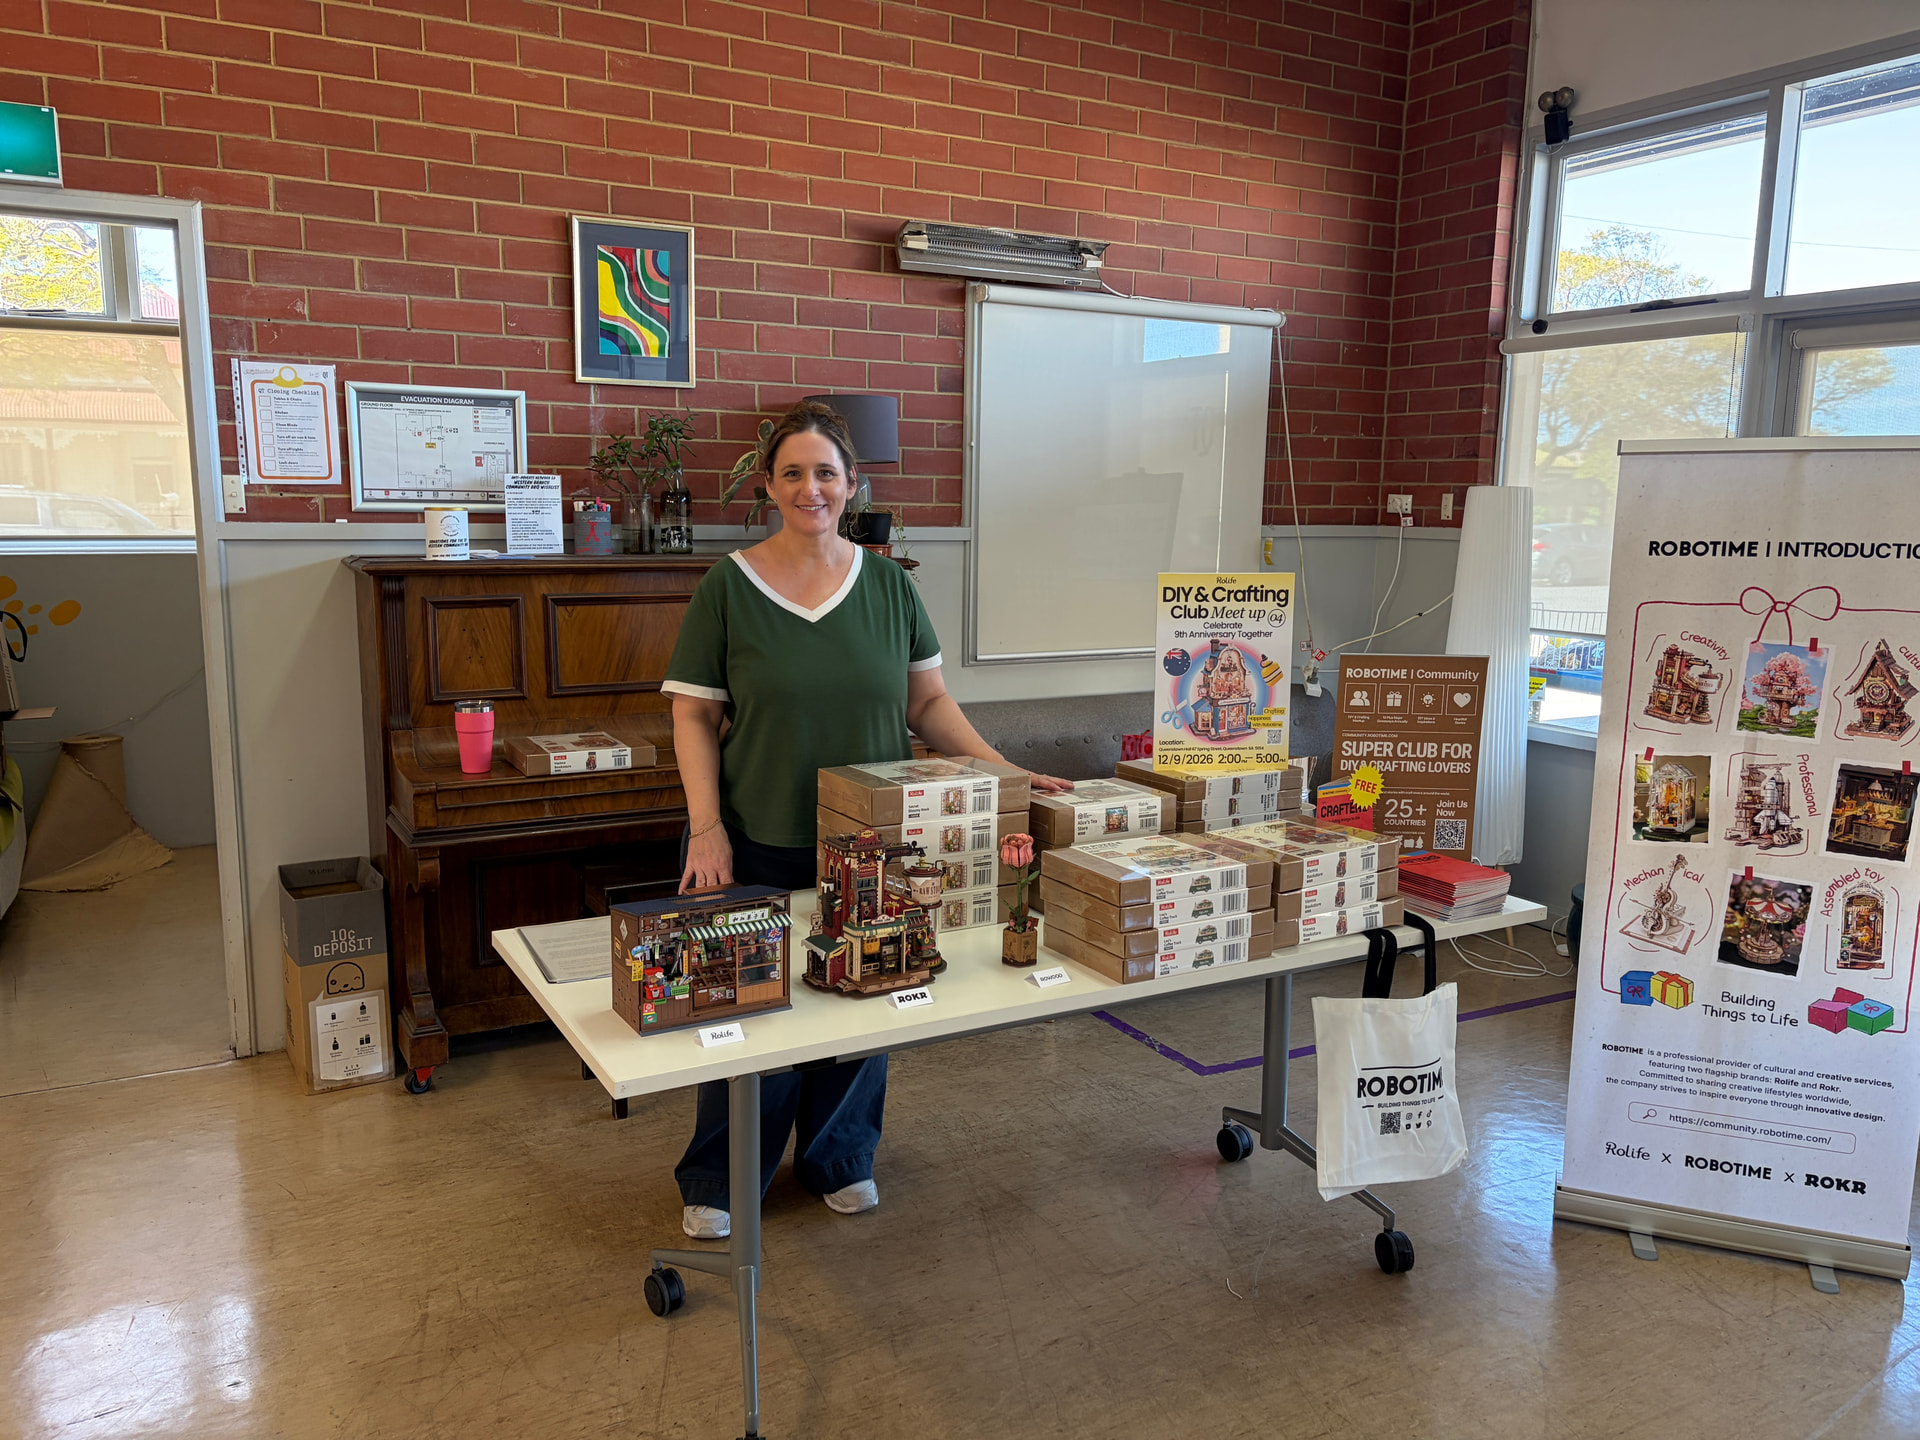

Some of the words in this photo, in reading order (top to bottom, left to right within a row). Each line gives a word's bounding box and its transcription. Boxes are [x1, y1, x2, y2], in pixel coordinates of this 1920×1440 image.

[401, 395, 443, 404] EVACUATION
[1648, 541, 1759, 557] ROBOTIME
[1216, 576, 1237, 585] Rolife
[1162, 586, 1193, 603] DIY
[1194, 586, 1210, 603] &
[1212, 585, 1289, 607] Crafting
[1170, 604, 1209, 619] Club
[1210, 606, 1246, 619] Meet
[1249, 608, 1266, 622] up
[1269, 613, 1283, 624] 04
[1174, 630, 1188, 638] 9th
[1189, 630, 1236, 640] Anniversary
[1238, 630, 1273, 640] Together
[1203, 622, 1243, 630] Celebrate
[1680, 630, 1731, 661] Creativity
[1346, 668, 1407, 679] ROBOTIME
[1416, 669, 1480, 682] Community
[1158, 754, 1214, 765] 12/9/2026
[1341, 741, 1393, 757] SUPER
[1397, 742, 1437, 758] CLUB
[1441, 743, 1472, 759] FOR
[1340, 760, 1359, 771] DIY
[1428, 762, 1471, 773] LOVERS
[1354, 778, 1378, 794] FREE
[1797, 754, 1821, 817] Professional
[1384, 799, 1427, 818] 25+
[1436, 800, 1455, 808] Join
[1436, 808, 1455, 817] Now
[1820, 868, 1861, 917] Assembled
[1865, 867, 1885, 884] toy
[313, 936, 373, 958] DEPOSIT
[897, 991, 928, 1004] ROKR
[1721, 991, 1776, 1011] Building
[1701, 1004, 1746, 1022] Things
[1751, 1012, 1766, 1023] to
[1770, 1013, 1799, 1027] Life
[710, 1030, 734, 1040] Rolife
[1602, 1043, 1644, 1055] ROBOTIME
[1663, 1051, 1714, 1064] professional
[1716, 1058, 1751, 1069] provider
[1753, 1063, 1762, 1071] of
[1764, 1065, 1796, 1075] cultural
[1798, 1069, 1814, 1078] and
[1816, 1072, 1852, 1083] creative
[1854, 1076, 1895, 1089] services,
[1648, 1060, 1686, 1072] featuring
[1687, 1065, 1703, 1074] two
[1705, 1067, 1739, 1080] flagship
[1740, 1072, 1772, 1083] brands:
[1774, 1077, 1799, 1087] Rolife
[1801, 1081, 1817, 1090] and
[1819, 1083, 1841, 1093] Rokr.
[1639, 1069, 1684, 1082] Committed
[1686, 1076, 1694, 1084] to
[1696, 1078, 1727, 1089] sharing
[1729, 1083, 1763, 1094] creative
[1764, 1087, 1803, 1099] lifestyles
[1805, 1092, 1852, 1107] worldwide,
[1606, 1076, 1619, 1084] the
[1620, 1078, 1658, 1091] company
[1660, 1085, 1687, 1094] strives
[1689, 1088, 1698, 1096] to
[1699, 1089, 1728, 1101] inspire
[1729, 1095, 1768, 1106] everyone
[1770, 1099, 1803, 1111] through
[1805, 1104, 1851, 1117] innovative
[1853, 1111, 1886, 1123] design.
[1669, 1114, 1832, 1146] https://community.robotime.com/
[1605, 1141, 1651, 1161] Rolife
[1684, 1155, 1772, 1180] ROBOTIME
[1804, 1174, 1868, 1195] ROKR
